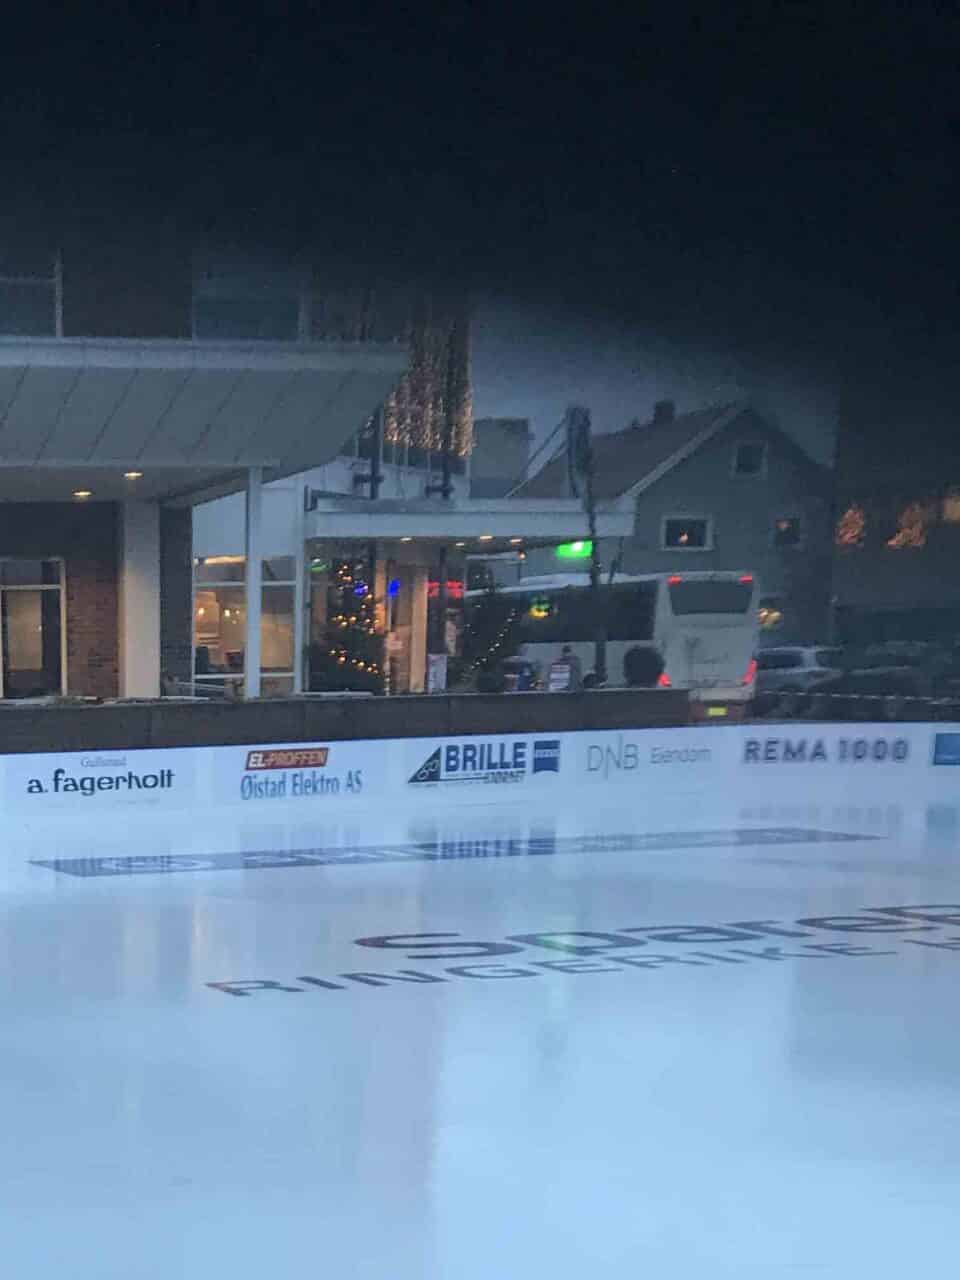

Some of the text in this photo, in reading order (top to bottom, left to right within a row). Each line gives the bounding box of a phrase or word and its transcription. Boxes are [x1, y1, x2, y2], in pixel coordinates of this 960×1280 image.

[247, 750, 328, 769] EL-PROFFEN
[444, 742, 528, 773] BRILLE
[586, 742, 640, 773] DNB
[743, 738, 909, 763] REMA 1000
[52, 768, 176, 797] fagerholt
[240, 769, 363, 799] Øistad Elektro AS
[205, 942, 898, 996] RINGERIKE
